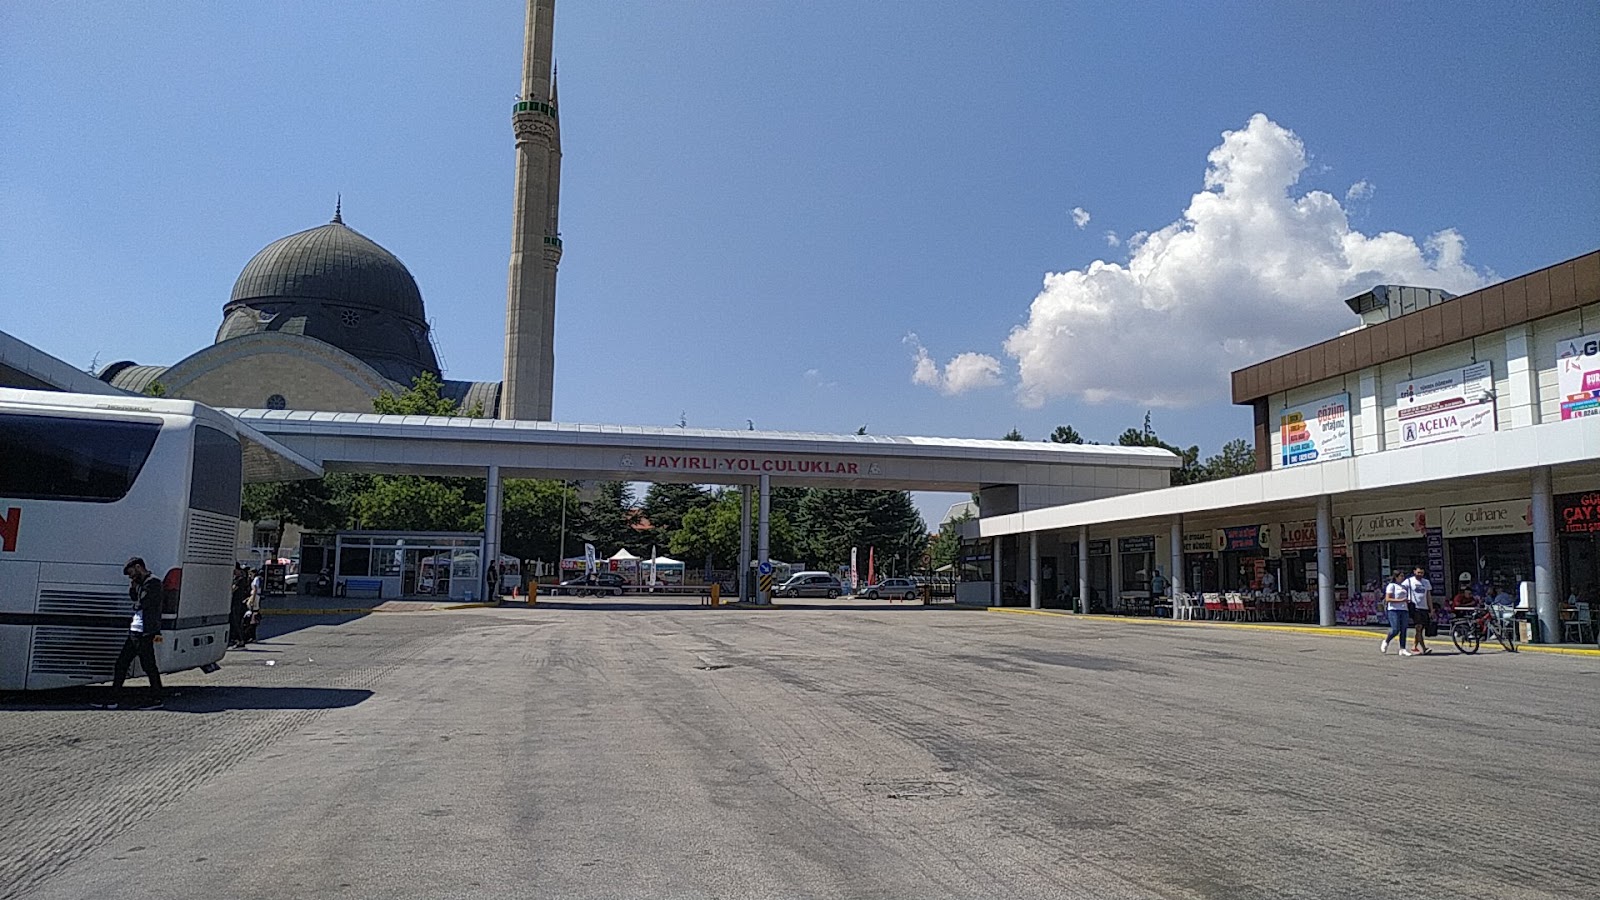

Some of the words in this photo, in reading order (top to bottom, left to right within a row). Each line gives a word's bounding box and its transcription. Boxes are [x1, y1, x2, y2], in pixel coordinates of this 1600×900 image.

[1418, 415, 1457, 434] AÇELYA
[645, 456, 717, 470] HAYIRLI
[724, 459, 858, 474] YOLCULUKLAR
[1369, 516, 1404, 532] gülhane
[1464, 507, 1508, 526] gülhane
[1563, 505, 1593, 524] ÇAY
